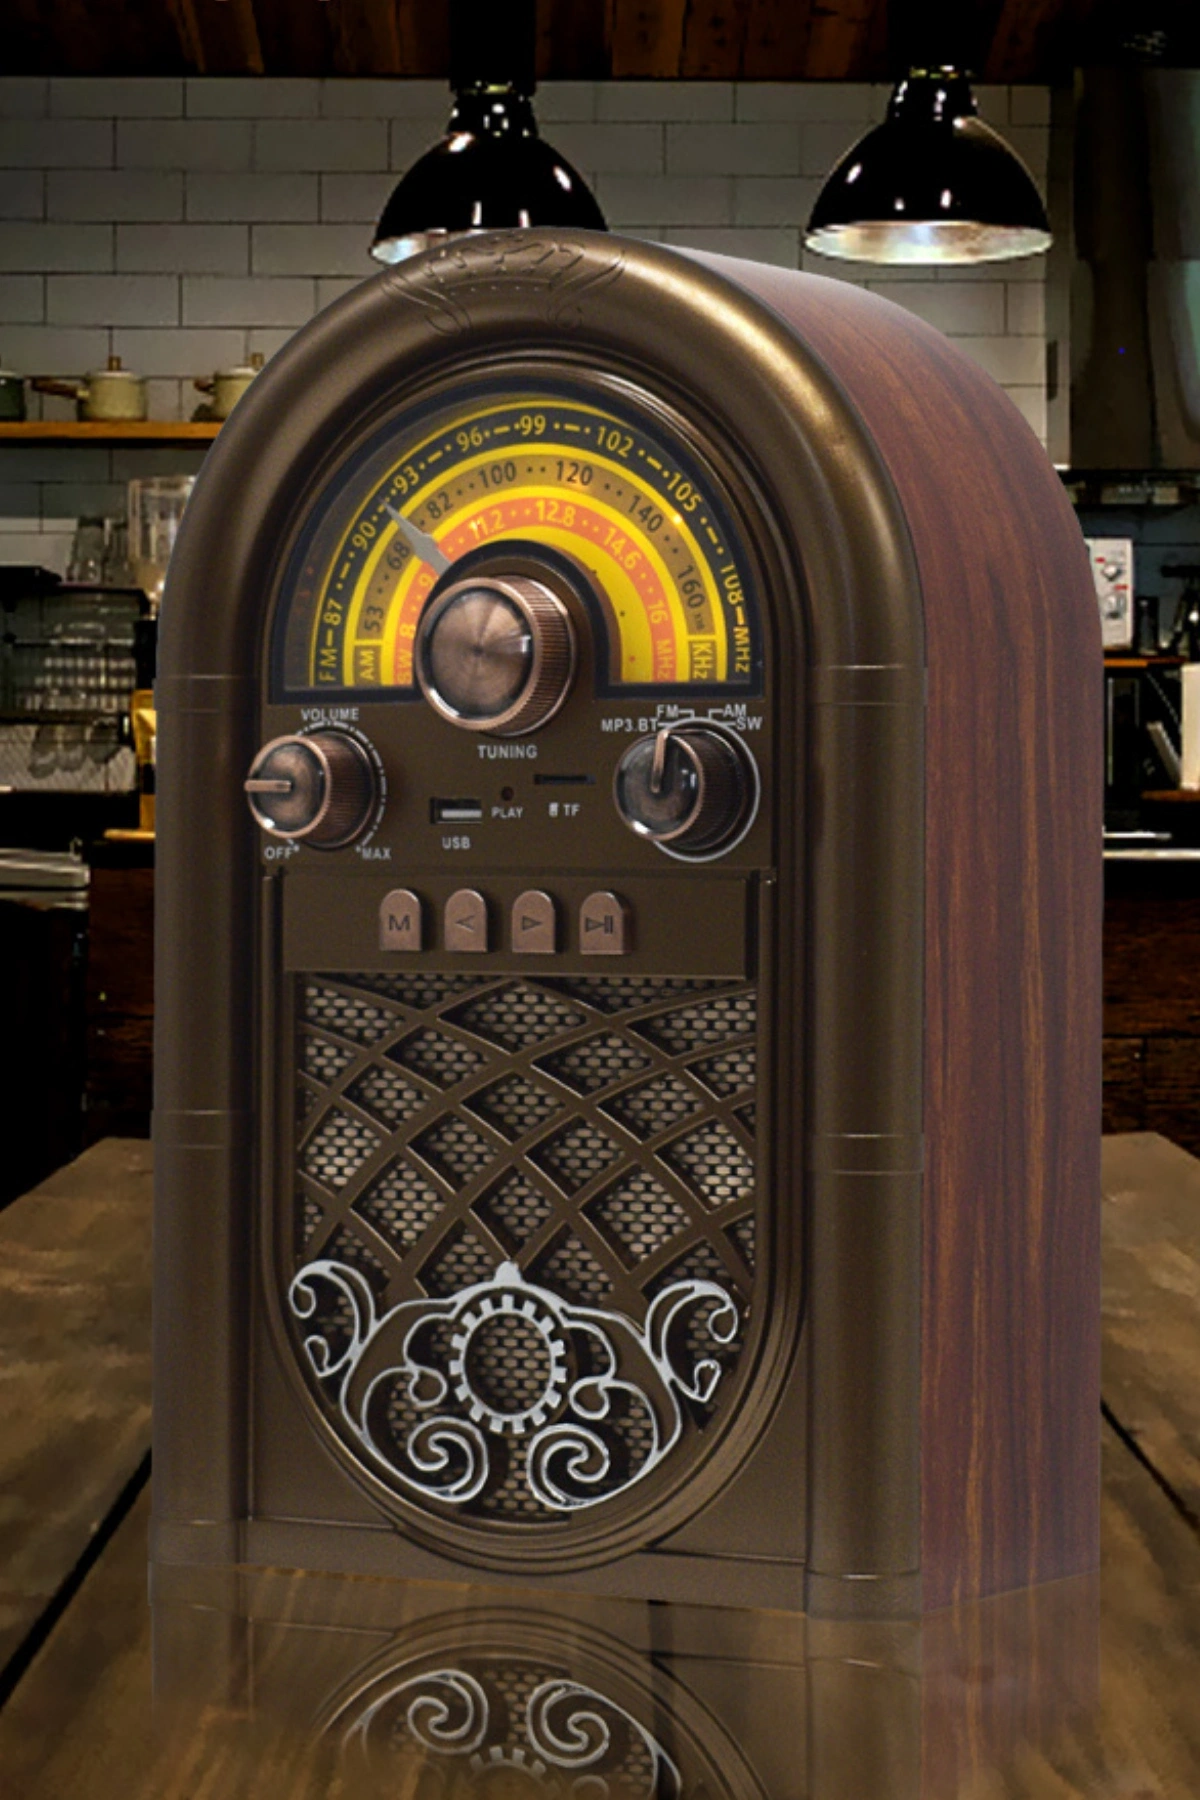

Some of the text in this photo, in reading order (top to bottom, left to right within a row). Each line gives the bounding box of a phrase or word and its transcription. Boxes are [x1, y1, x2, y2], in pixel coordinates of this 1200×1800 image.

[519, 415, 546, 435] 99
[456, 426, 483, 451] 96
[596, 426, 635, 458] 102
[393, 464, 420, 494] 93
[665, 472, 702, 512] 105
[352, 521, 377, 550] 90
[359, 461, 713, 680] AM 53 68 82 100 120 140 160 KHz
[469, 510, 505, 540] 11.2
[536, 500, 577, 526] 12.8
[603, 528, 642, 569] 14.6
[648, 602, 668, 623] 16
[720, 564, 745, 605] 108
[323, 598, 343, 625] 87
[320, 646, 337, 682] FM
[301, 708, 360, 721] VOLUME
[656, 705, 679, 718] FM
[723, 704, 747, 718] AM
[736, 717, 763, 731] SW
[477, 745, 538, 760] TUNING
[491, 807, 524, 819] PLAY
[563, 804, 580, 816] TF
[442, 837, 471, 850] USB
[264, 846, 293, 860] OFF
[361, 847, 392, 860] MAX
[388, 914, 411, 931] M
